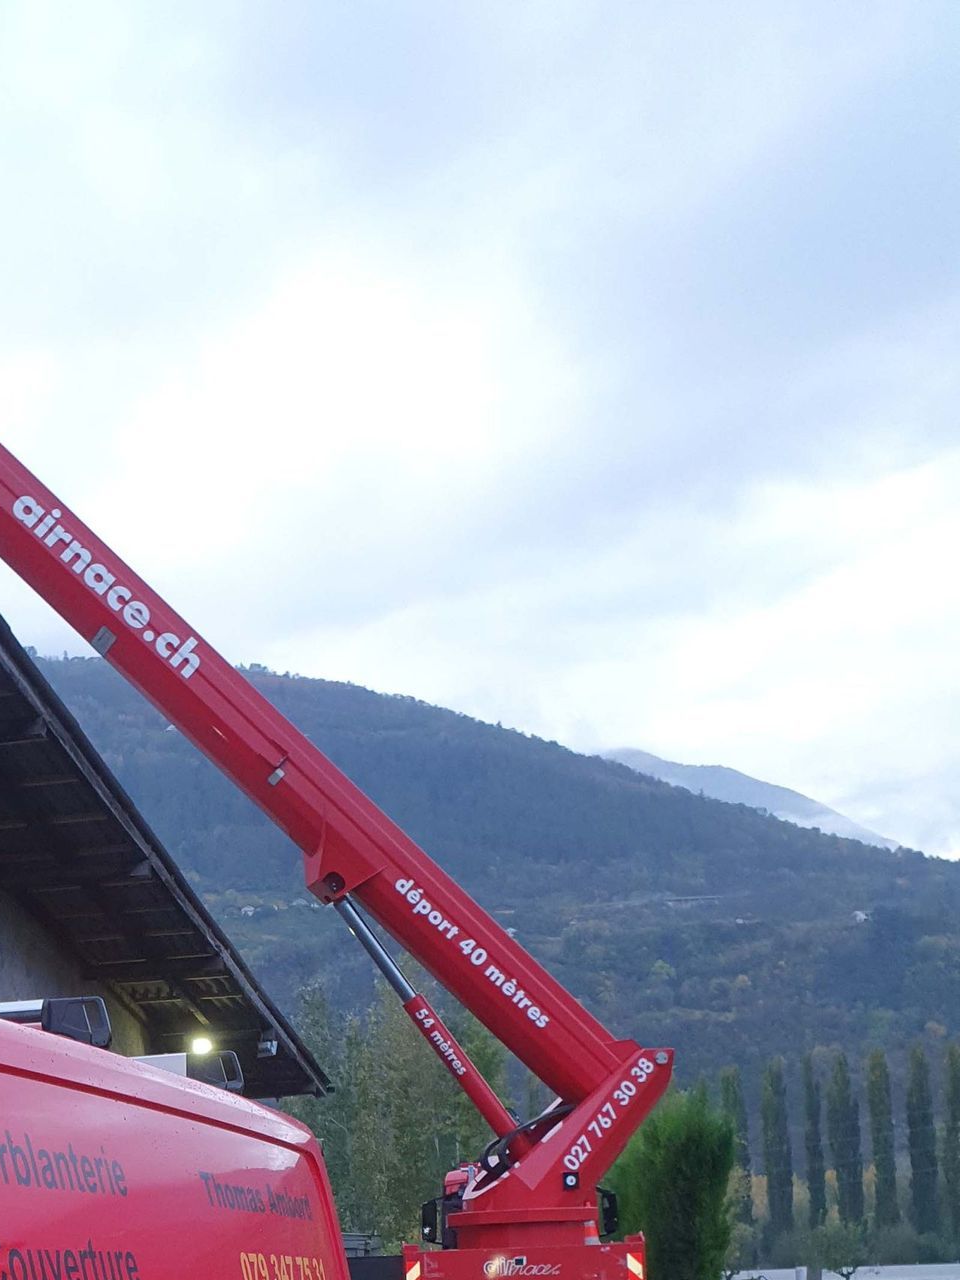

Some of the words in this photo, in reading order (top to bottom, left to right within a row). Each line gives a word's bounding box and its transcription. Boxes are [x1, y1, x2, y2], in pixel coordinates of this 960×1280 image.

[13, 495, 201, 679] airnace.ch
[395, 879, 459, 940] déport
[459, 939, 488, 966] 40
[484, 965, 550, 1028] mètres
[415, 1008, 435, 1029] 54
[430, 1030, 467, 1076] mètres
[563, 1134, 592, 1170] 027
[587, 1102, 617, 1138] 767
[613, 1080, 636, 1106] 30
[630, 1057, 654, 1083] 38
[199, 1171, 265, 1213] Thomas
